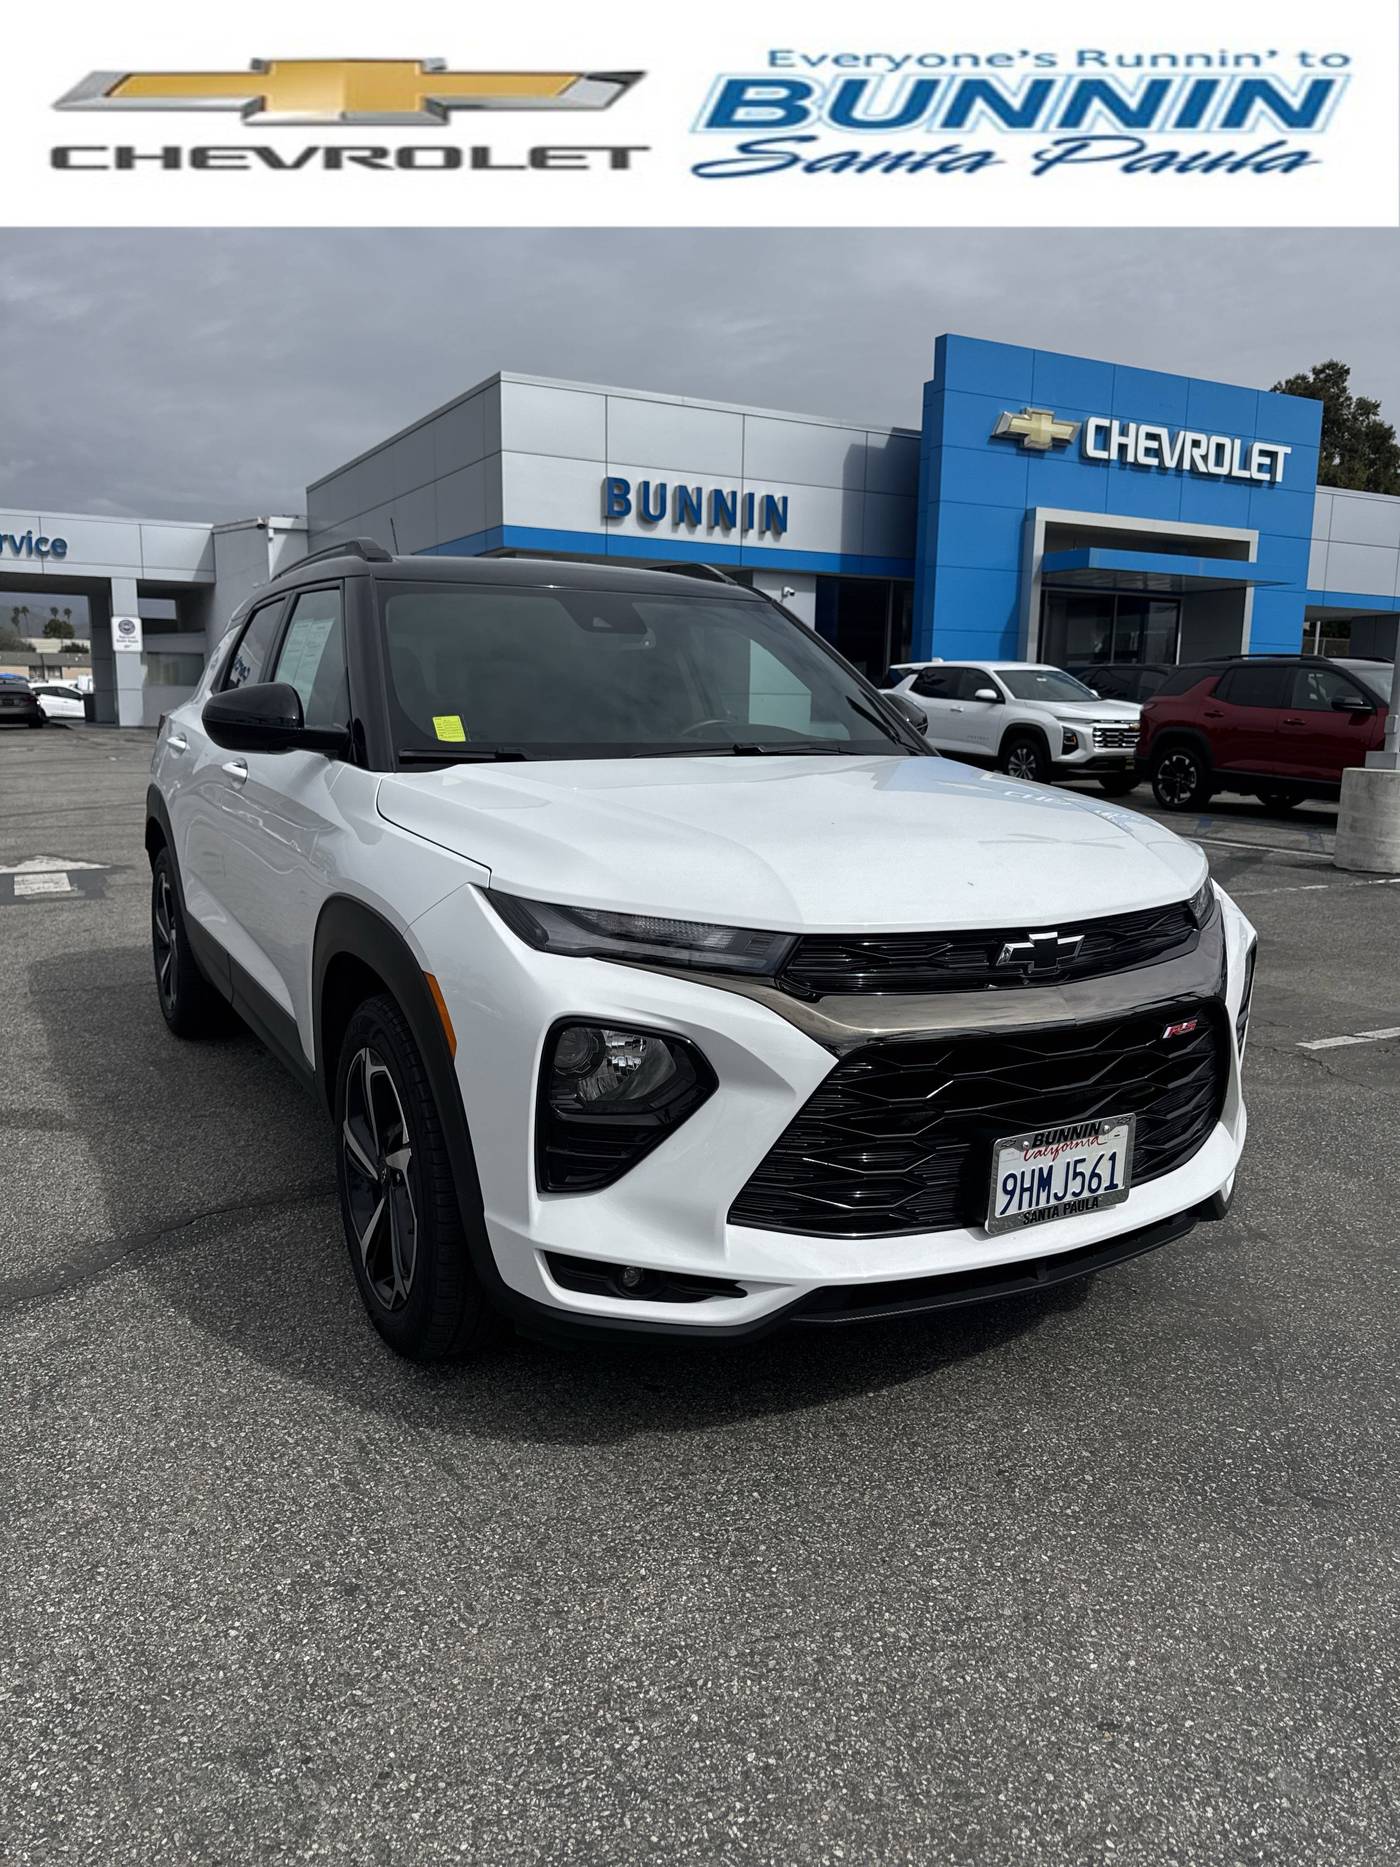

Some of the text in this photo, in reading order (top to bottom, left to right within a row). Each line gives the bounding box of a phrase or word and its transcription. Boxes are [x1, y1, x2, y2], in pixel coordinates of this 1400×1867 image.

[1083, 416, 1292, 483] CHEVROLET
[602, 476, 788, 535] BUNNIN
[1023, 1135, 1107, 1162] California
[1032, 1121, 1103, 1148] BUNNIN
[1000, 1151, 1119, 1216] 9HMJ561
[1022, 1196, 1099, 1226] SANTA PAULA
